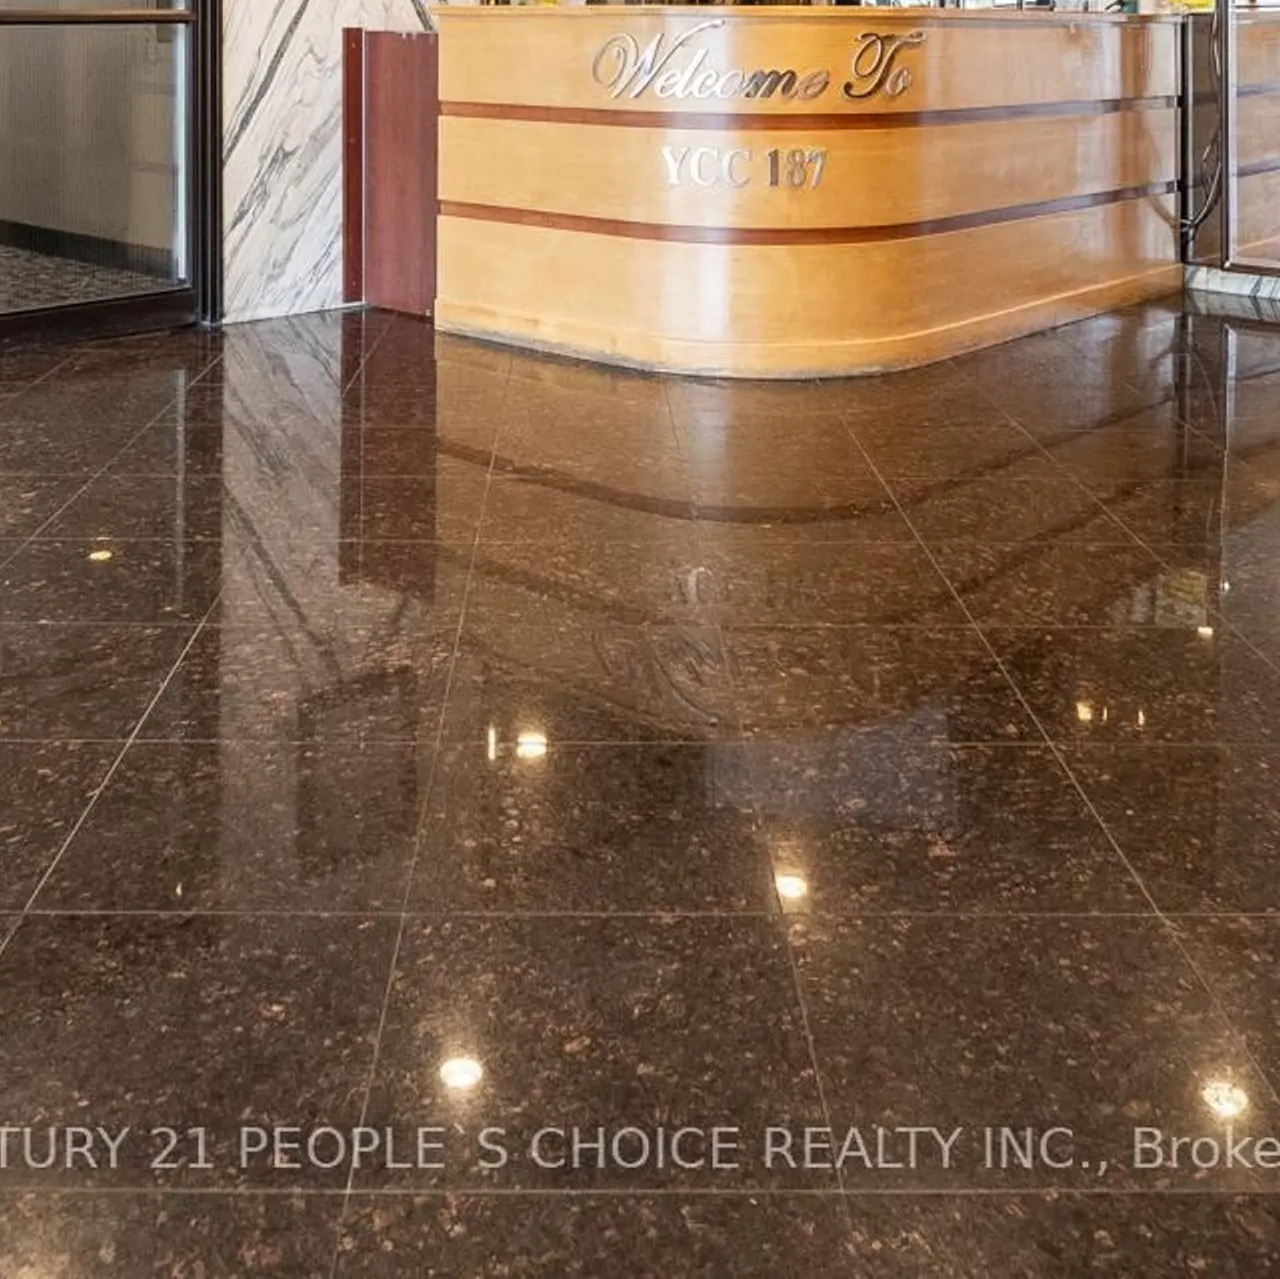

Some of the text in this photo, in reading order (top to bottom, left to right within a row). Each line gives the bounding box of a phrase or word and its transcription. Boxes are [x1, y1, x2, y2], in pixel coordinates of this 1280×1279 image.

[592, 19, 926, 100] Welcome To
[661, 145, 827, 191] YCC 187
